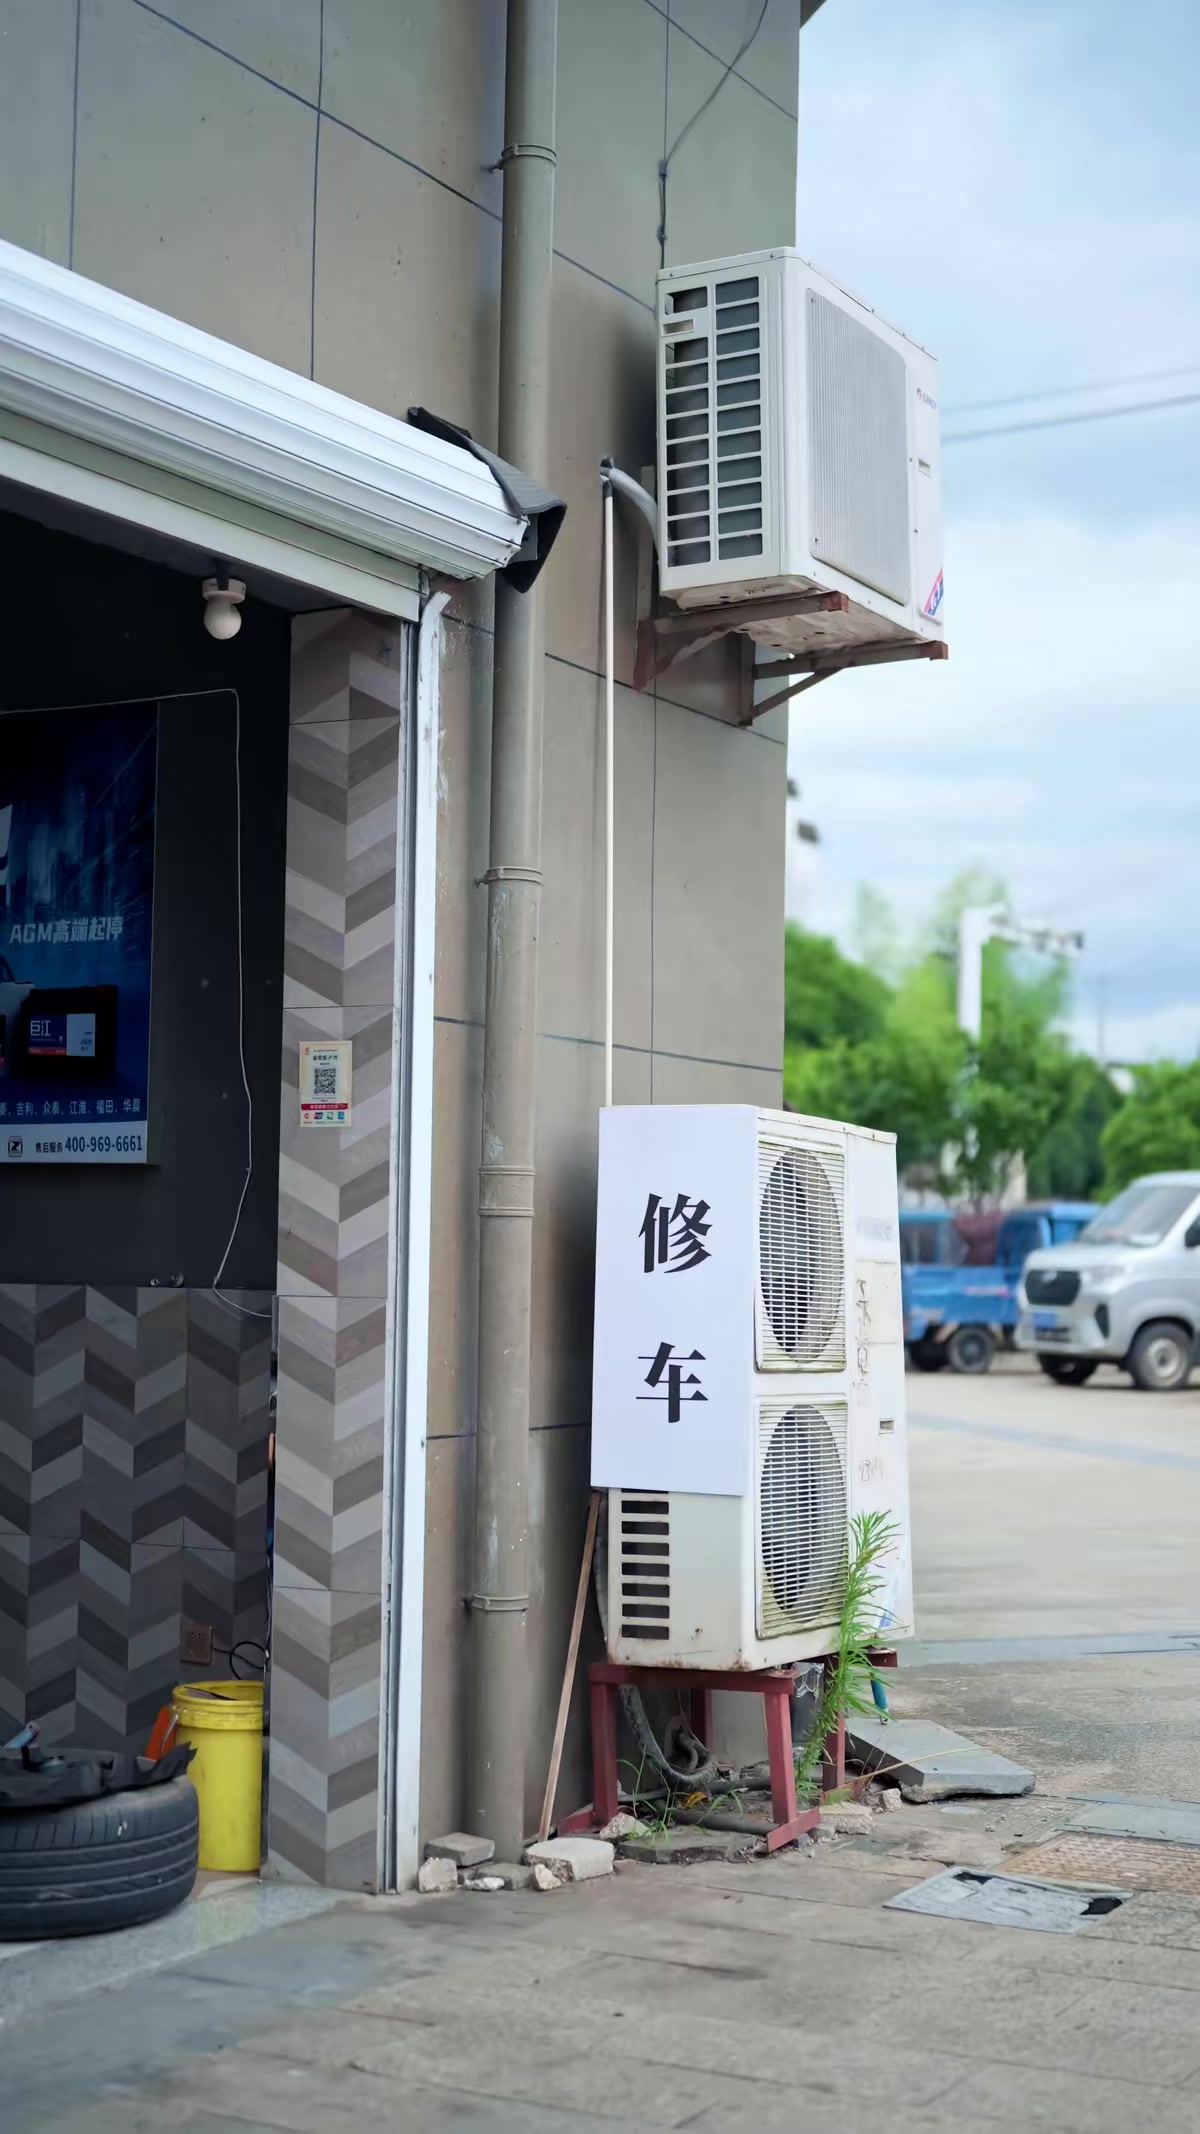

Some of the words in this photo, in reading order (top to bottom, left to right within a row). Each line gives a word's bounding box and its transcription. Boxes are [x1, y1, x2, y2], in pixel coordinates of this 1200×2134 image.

[9, 916, 125, 944] AGM高端起停
[65, 1135, 142, 1152] 400-969-6661
[636, 1193, 713, 1424] 修车
